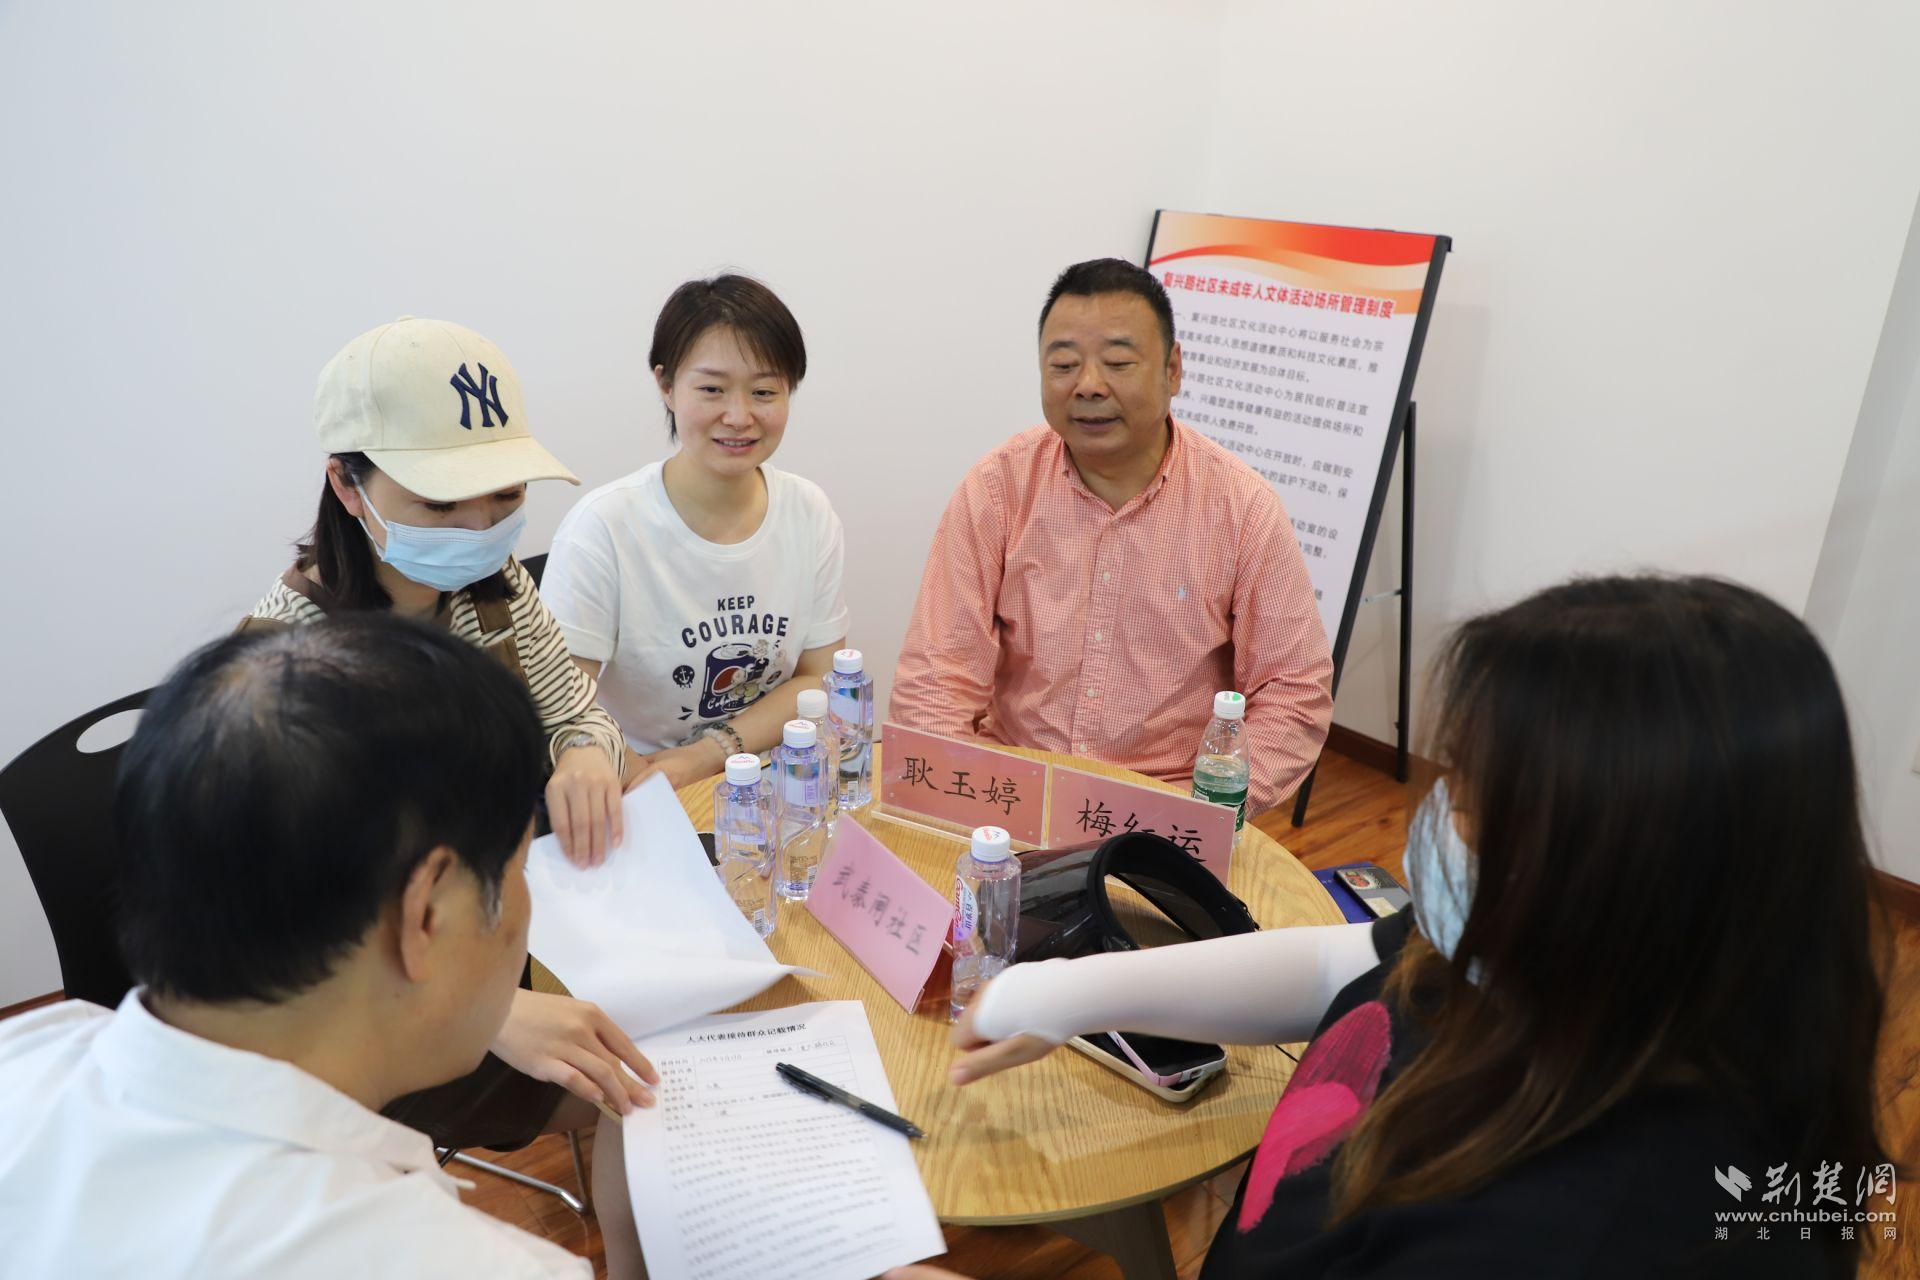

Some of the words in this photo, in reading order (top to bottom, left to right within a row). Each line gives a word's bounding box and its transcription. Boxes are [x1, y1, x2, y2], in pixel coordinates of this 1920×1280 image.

[1163, 271, 1395, 320] 复兴路社区未成年人文体活动场所管理制度
[450, 362, 509, 430] NY
[717, 595, 755, 611] KEEP
[682, 613, 789, 648] COURAGE
[901, 757, 1022, 816] 耿玉婷
